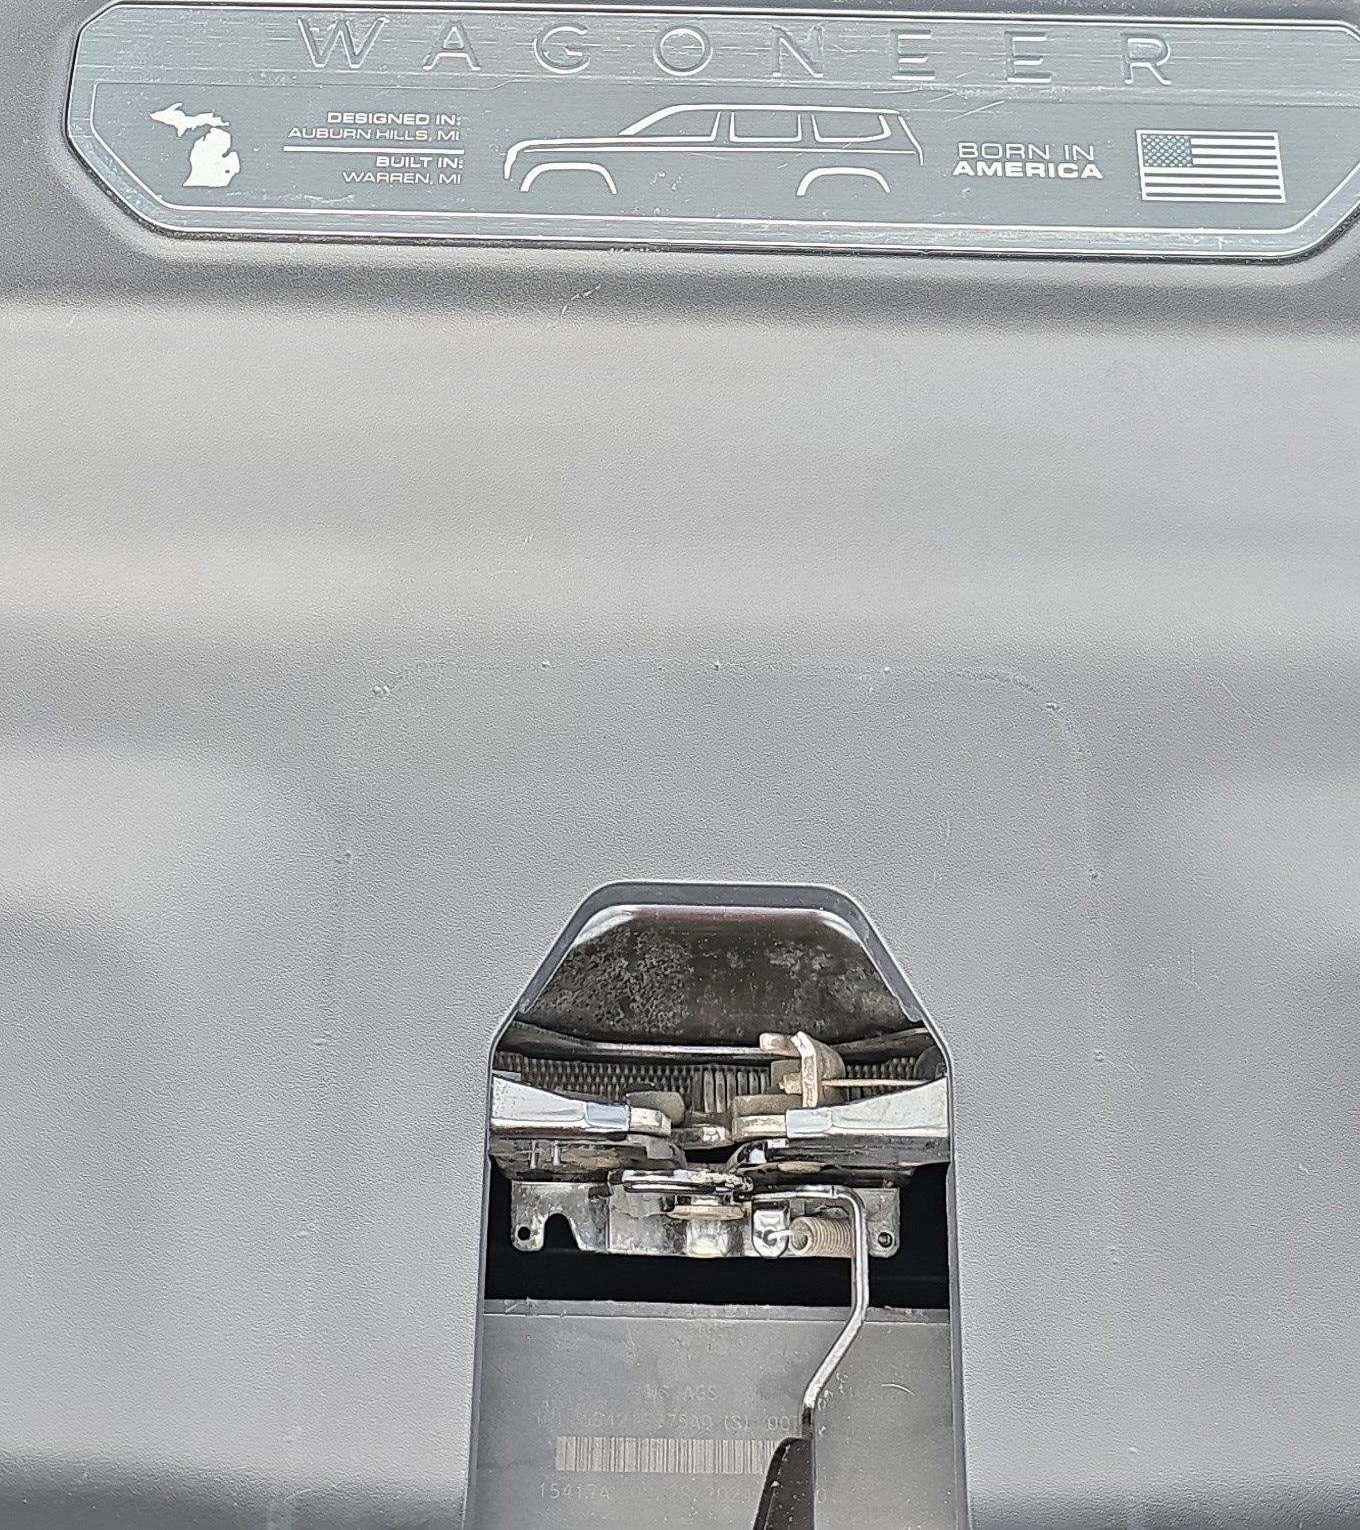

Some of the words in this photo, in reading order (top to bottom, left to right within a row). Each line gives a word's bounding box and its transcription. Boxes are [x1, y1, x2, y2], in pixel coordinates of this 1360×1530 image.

[297, 16, 1174, 86] WAGONEER
[327, 111, 430, 126] DESIGNED
[436, 114, 462, 126] IN:
[288, 127, 372, 140] AUBURN
[376, 129, 433, 142] HILLS,
[437, 131, 460, 141] MI
[957, 141, 1051, 160] BORN
[1064, 143, 1096, 161] IN
[376, 155, 433, 169] BUILT
[438, 157, 464, 169] IN:
[952, 160, 1104, 180] AMERICA
[342, 171, 434, 185] WARREN,
[438, 173, 462, 185] MI
